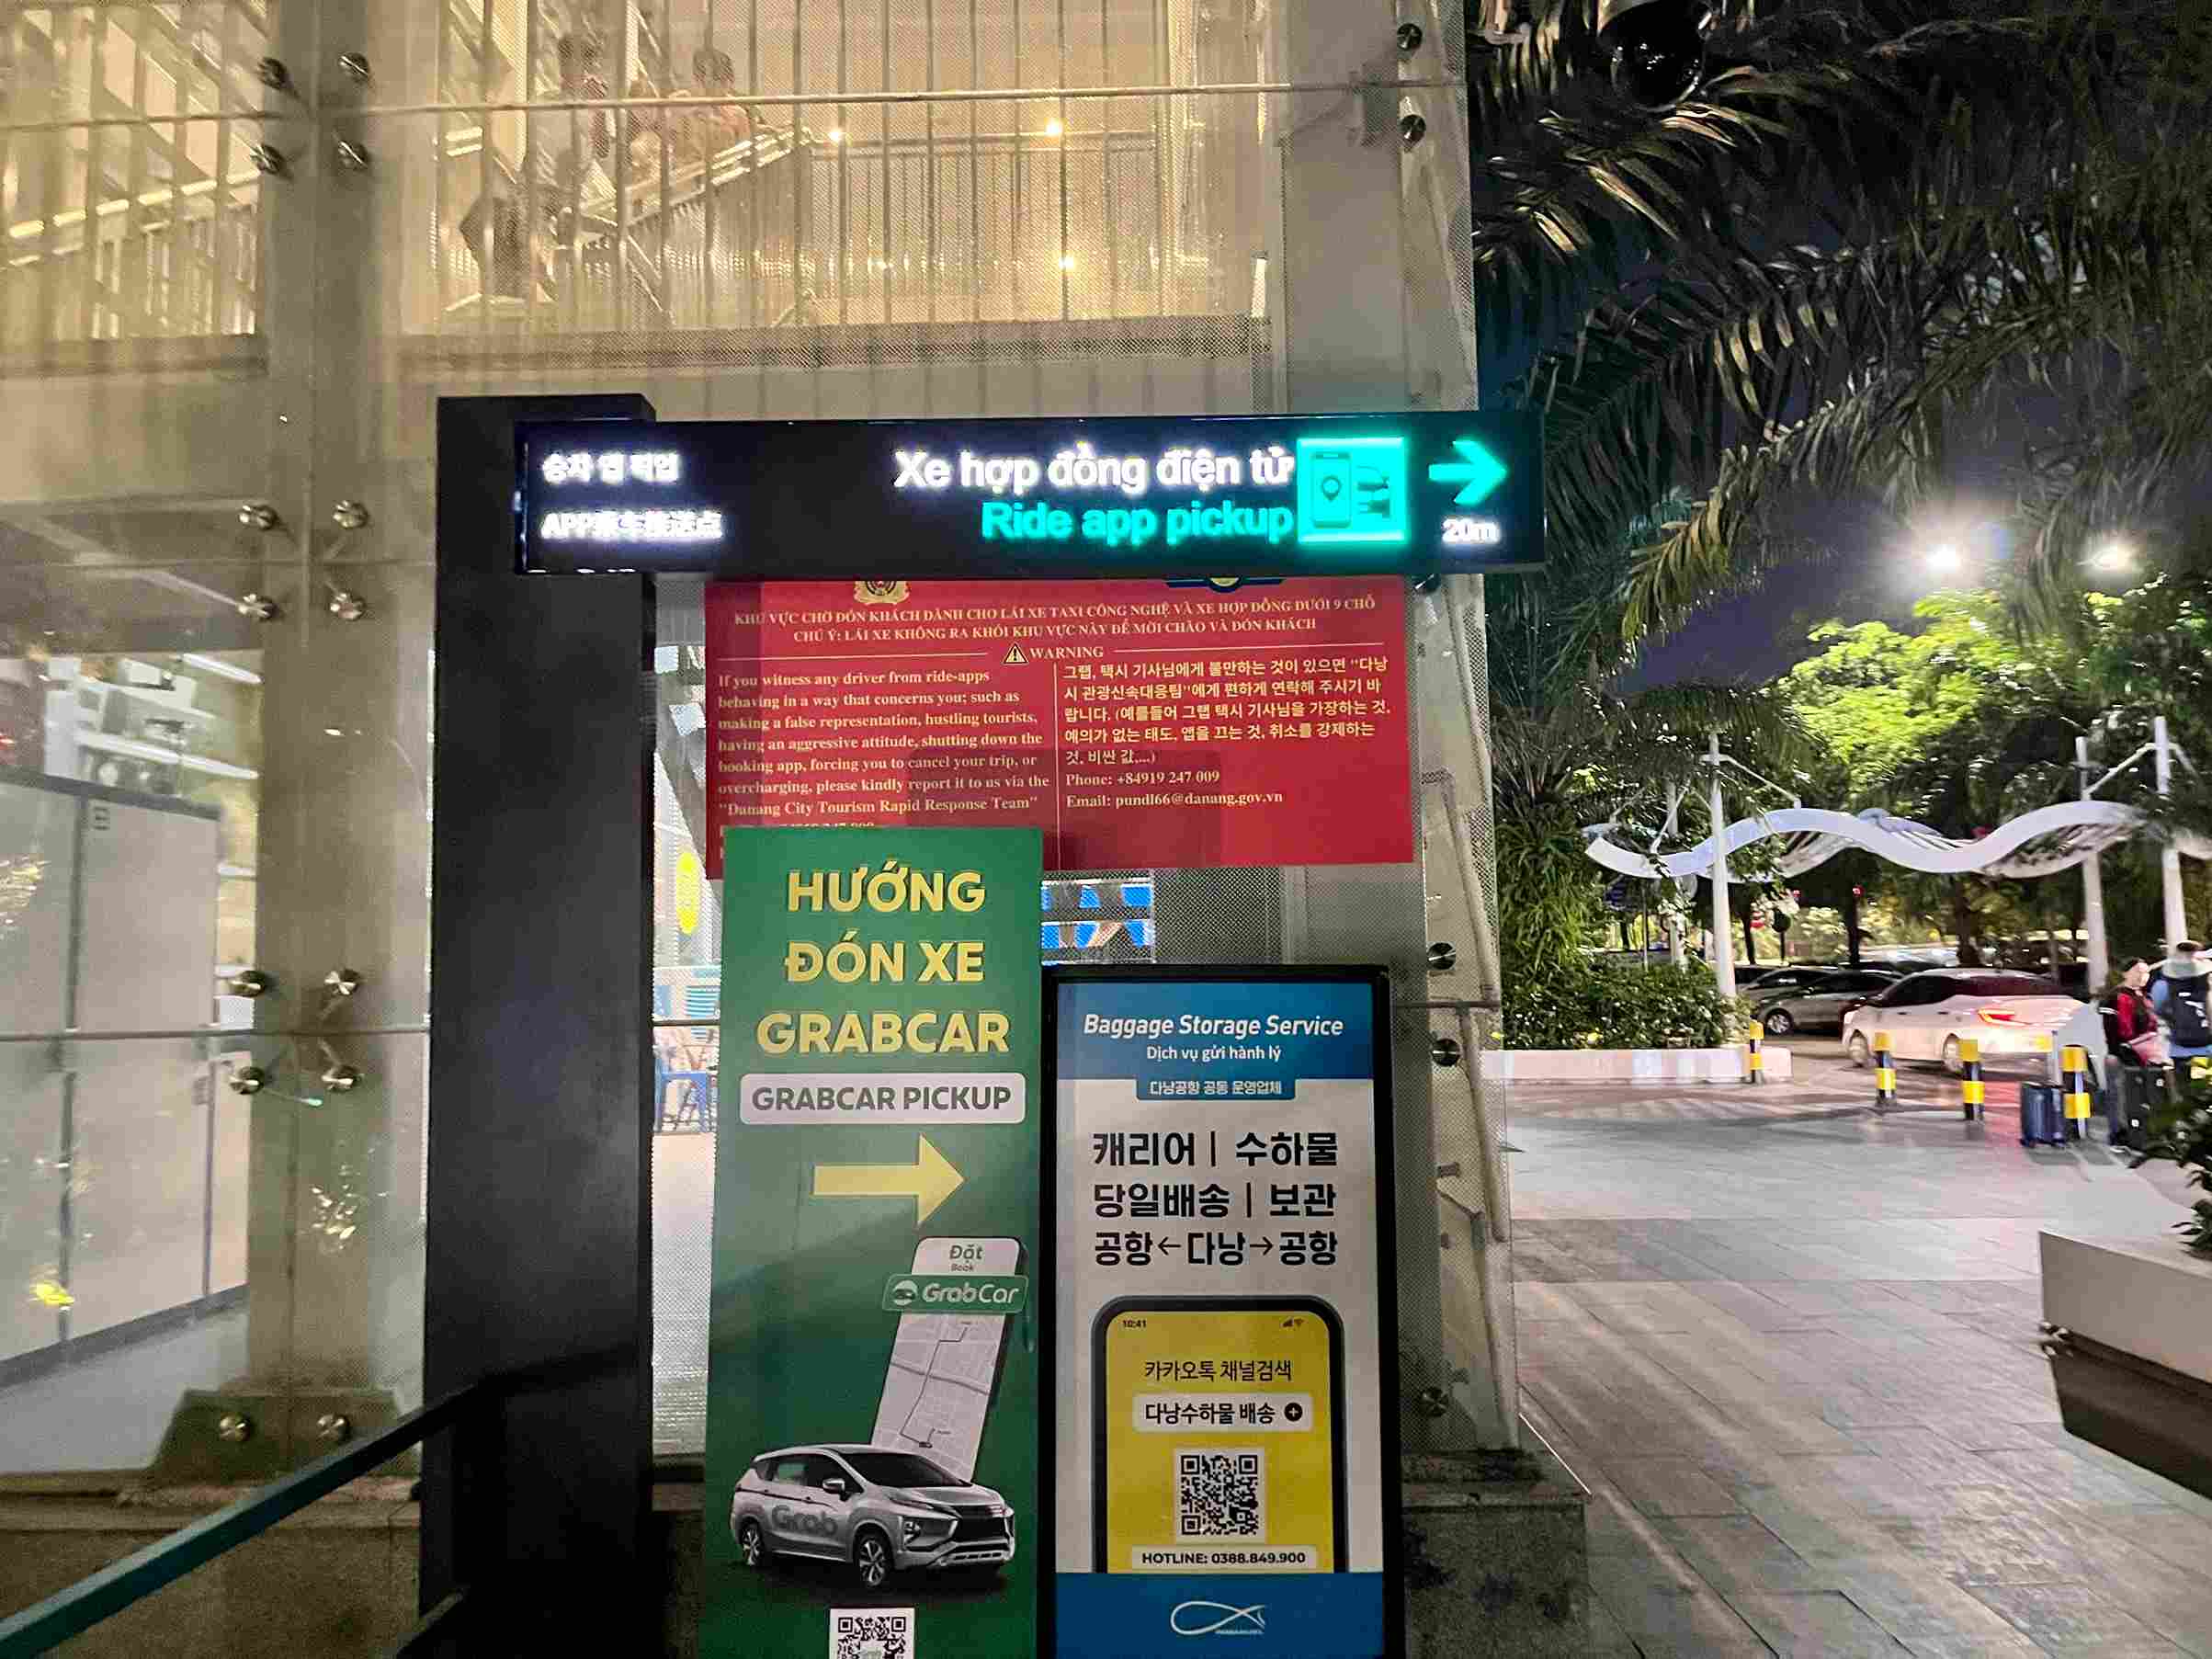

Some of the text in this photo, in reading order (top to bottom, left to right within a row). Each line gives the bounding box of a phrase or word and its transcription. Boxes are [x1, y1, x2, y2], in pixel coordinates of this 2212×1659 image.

[895, 440, 1295, 497] Xe hợp đồng điện tử
[981, 500, 1294, 546] Ride app pickup
[1442, 517, 1501, 543] 20m
[735, 611, 765, 625] KHU
[869, 608, 920, 621] KHÁCH
[967, 608, 996, 619] CHO
[1028, 608, 1046, 619] XE
[1050, 607, 1083, 618] TAXI
[1197, 602, 1213, 614] XE
[1333, 598, 1341, 610] 9
[873, 629, 890, 641] XE
[950, 628, 968, 639] RA
[1013, 625, 1042, 637] KHU
[1029, 646, 1104, 660] WARNING
[1101, 663, 1129, 678] 택시
[1133, 661, 1204, 679] 기사님에게
[1270, 657, 1299, 676] 것이
[1303, 657, 1346, 674] 있으면
[719, 670, 990, 689] If you witness any driver from ride-apps
[1064, 676, 1381, 701] 시 편하게 연락해 주시기 바
[719, 691, 1020, 710] behaving in a way that concerns such as
[1182, 699, 1368, 721] 그랩 택시 기사님을 가장하는
[719, 717, 769, 731] making
[773, 720, 781, 729] a
[785, 716, 816, 728] false
[1112, 727, 1140, 744] 없는
[1215, 724, 1242, 741] 끄는
[1316, 720, 1376, 739] 강제하는
[719, 739, 765, 754] having
[767, 740, 785, 750] an
[788, 736, 857, 753] aggressive
[922, 734, 979, 749] shutting
[981, 733, 1017, 745] down
[1021, 733, 1044, 744] the
[718, 756, 1038, 774] booking forcing you to cancel your or
[1088, 749, 1117, 765] 비싼
[816, 778, 857, 794] please
[861, 778, 904, 794] kindly
[908, 778, 950, 793] report
[955, 777, 965, 789] it
[969, 778, 981, 789] to
[985, 778, 1000, 789] us
[1004, 776, 1025, 788] via
[1028, 775, 1049, 787] the
[1066, 770, 1220, 787] Phone: +84919 247 009
[785, 801, 812, 817] City
[816, 800, 875, 814] Tourism
[879, 799, 920, 815] Rapid
[925, 798, 987, 813] Response
[1066, 794, 1111, 809] Email:
[788, 861, 986, 913] HƯỚNG
[784, 930, 984, 983] ĐÓN XE
[756, 1012, 1010, 1054] GRABCAR
[1083, 1014, 1344, 1040] Baggage Storage Service
[1146, 1044, 1281, 1062] Dịch vụ gửi hành lý
[752, 1086, 1011, 1111] GRABCAR PICKUP
[1150, 1080, 1282, 1096] 다낭공항 공동 운영업체
[1093, 1131, 1338, 1167] 캐리어 수하물
[1095, 1182, 1336, 1219] 당일배송 보관
[949, 1244, 983, 1263] Đặt
[1095, 1231, 1338, 1267] 공항 다낭 공항
[922, 1282, 1019, 1303] GrabCar
[1123, 1319, 1147, 1328] 10:41
[1145, 1360, 1292, 1381] 카카오톡 채널검색
[1145, 1402, 1276, 1425] 다낭수하물 배송
[772, 1505, 838, 1538] Grab
[1142, 1552, 1306, 1564] HOTLINE: 0388.849.900
